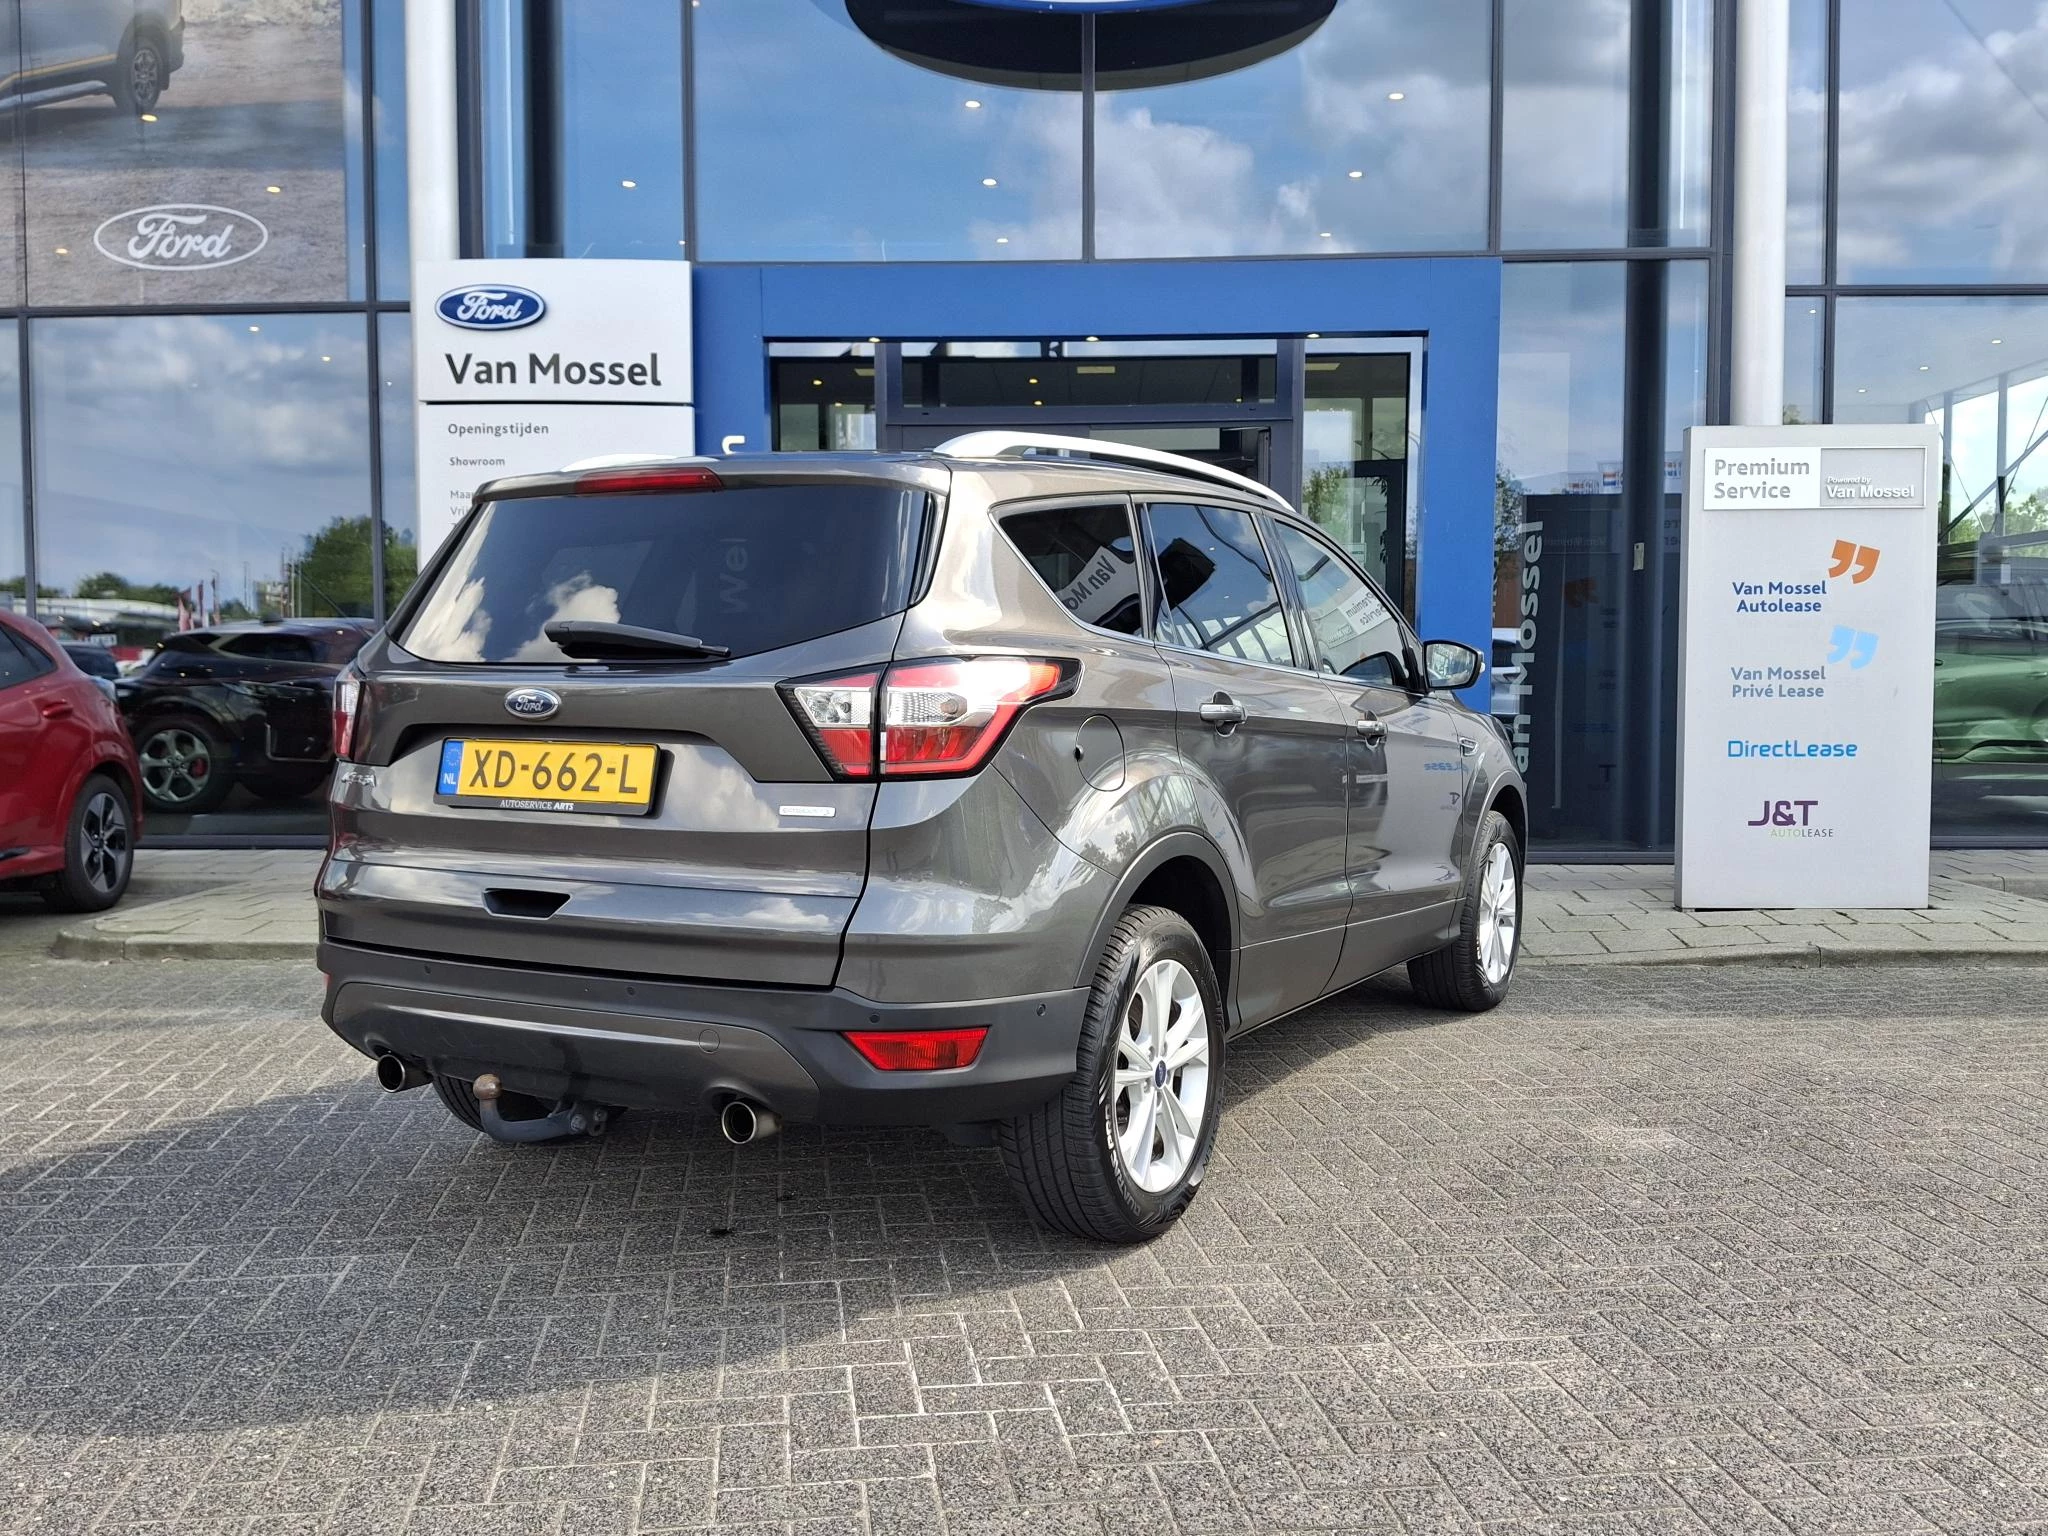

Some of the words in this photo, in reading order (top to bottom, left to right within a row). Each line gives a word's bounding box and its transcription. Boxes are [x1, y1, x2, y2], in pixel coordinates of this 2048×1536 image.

[127, 213, 234, 259] Ford
[456, 291, 523, 320] Ford
[445, 353, 517, 384] Van
[529, 353, 662, 386] Mossel
[448, 423, 549, 437] Openingstijden
[449, 457, 506, 466] Showroom
[1714, 458, 1810, 475] Premium
[1826, 476, 1860, 484] Powered
[1861, 477, 1871, 485] by
[1713, 482, 1791, 499] Service
[1827, 485, 1856, 498] Van
[1860, 484, 1915, 498] Mossel
[1732, 582, 1763, 595] Van
[1768, 581, 1827, 595] Mossel
[1511, 520, 1543, 696] Mossel
[1736, 600, 1822, 613] Autolease
[1731, 667, 1762, 680] Van
[1767, 666, 1826, 680] Mossel
[1732, 684, 1774, 698] Privé
[1778, 685, 1825, 698] Lease
[515, 695, 544, 711] Ford
[1727, 740, 1858, 758] DirectLease
[443, 772, 457, 785] NL
[469, 749, 638, 794] XD-662-L
[500, 799, 553, 809] AUTOSERVICE
[553, 802, 575, 811] ARTS
[1747, 800, 1819, 826] J&T
[1770, 828, 1834, 838] AUTOLEASE
